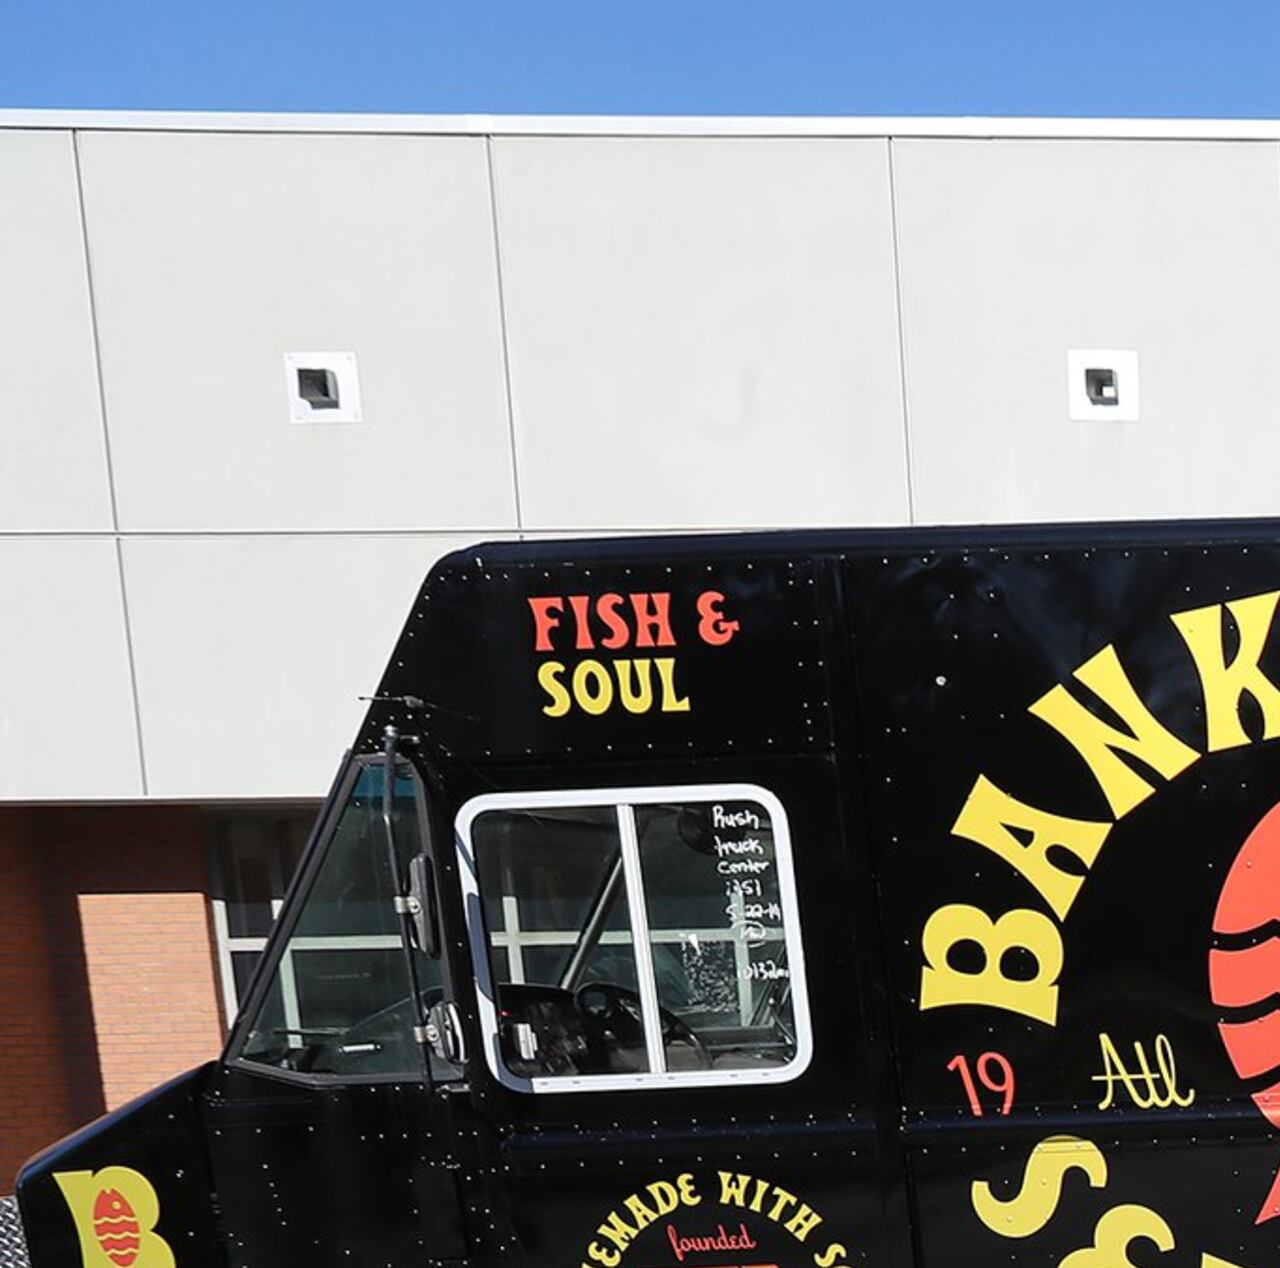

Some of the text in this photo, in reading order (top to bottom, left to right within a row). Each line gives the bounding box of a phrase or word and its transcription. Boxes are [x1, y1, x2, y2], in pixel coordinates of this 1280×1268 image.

[527, 590, 740, 652] FISH &
[537, 657, 692, 718] SOUL
[712, 805, 760, 829] Rush
[946, 1050, 1016, 1117] 19
[718, 1170, 823, 1242] WITH
[667, 1223, 757, 1262] founded
